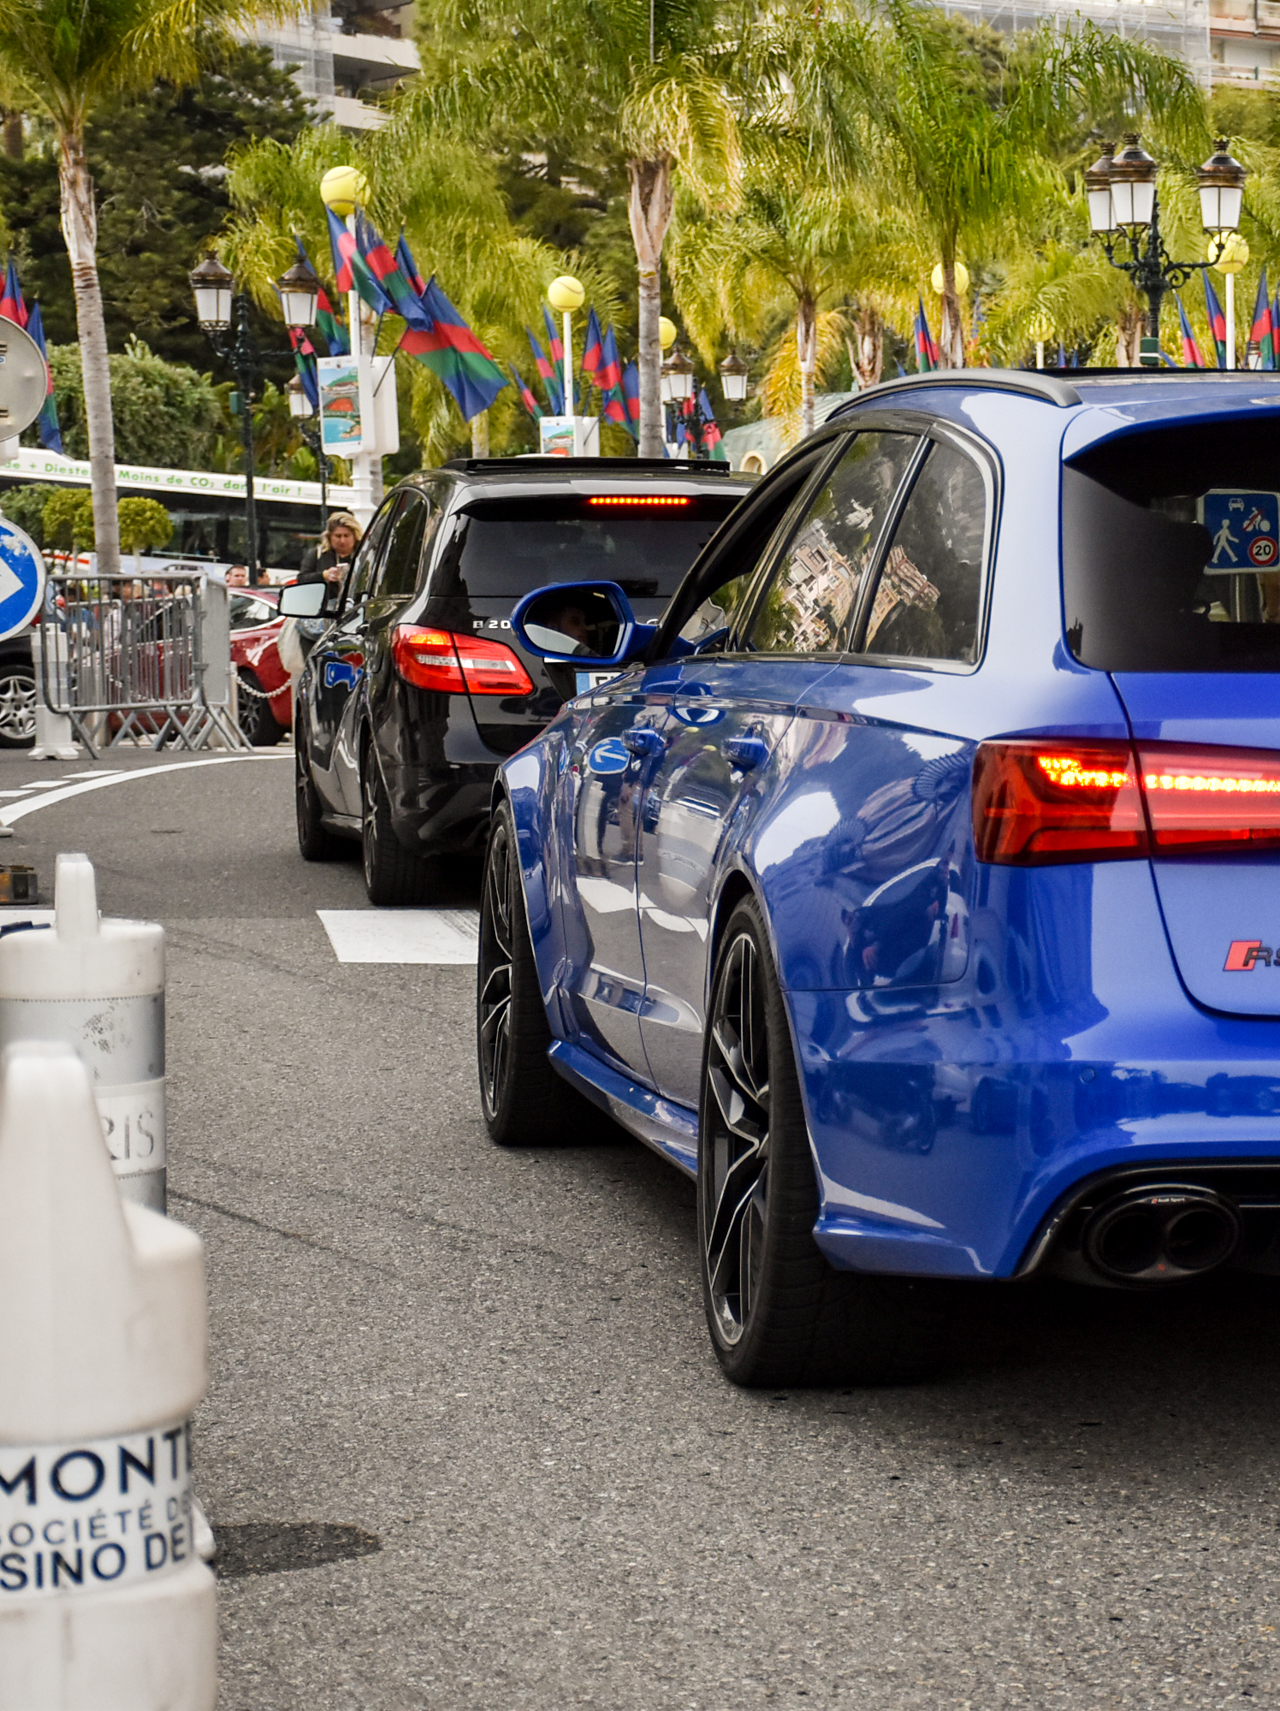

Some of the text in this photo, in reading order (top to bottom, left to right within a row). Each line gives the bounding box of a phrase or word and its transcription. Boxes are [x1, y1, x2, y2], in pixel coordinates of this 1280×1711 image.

[118, 470, 160, 483] Moins
[167, 472, 183, 485] de
[1254, 544, 1272, 556] 20
[473, 620, 484, 629] B
[0, 1499, 152, 1548] OCIÉTÉ
[0, 1542, 126, 1592] SINO
[145, 1523, 187, 1572] DE
